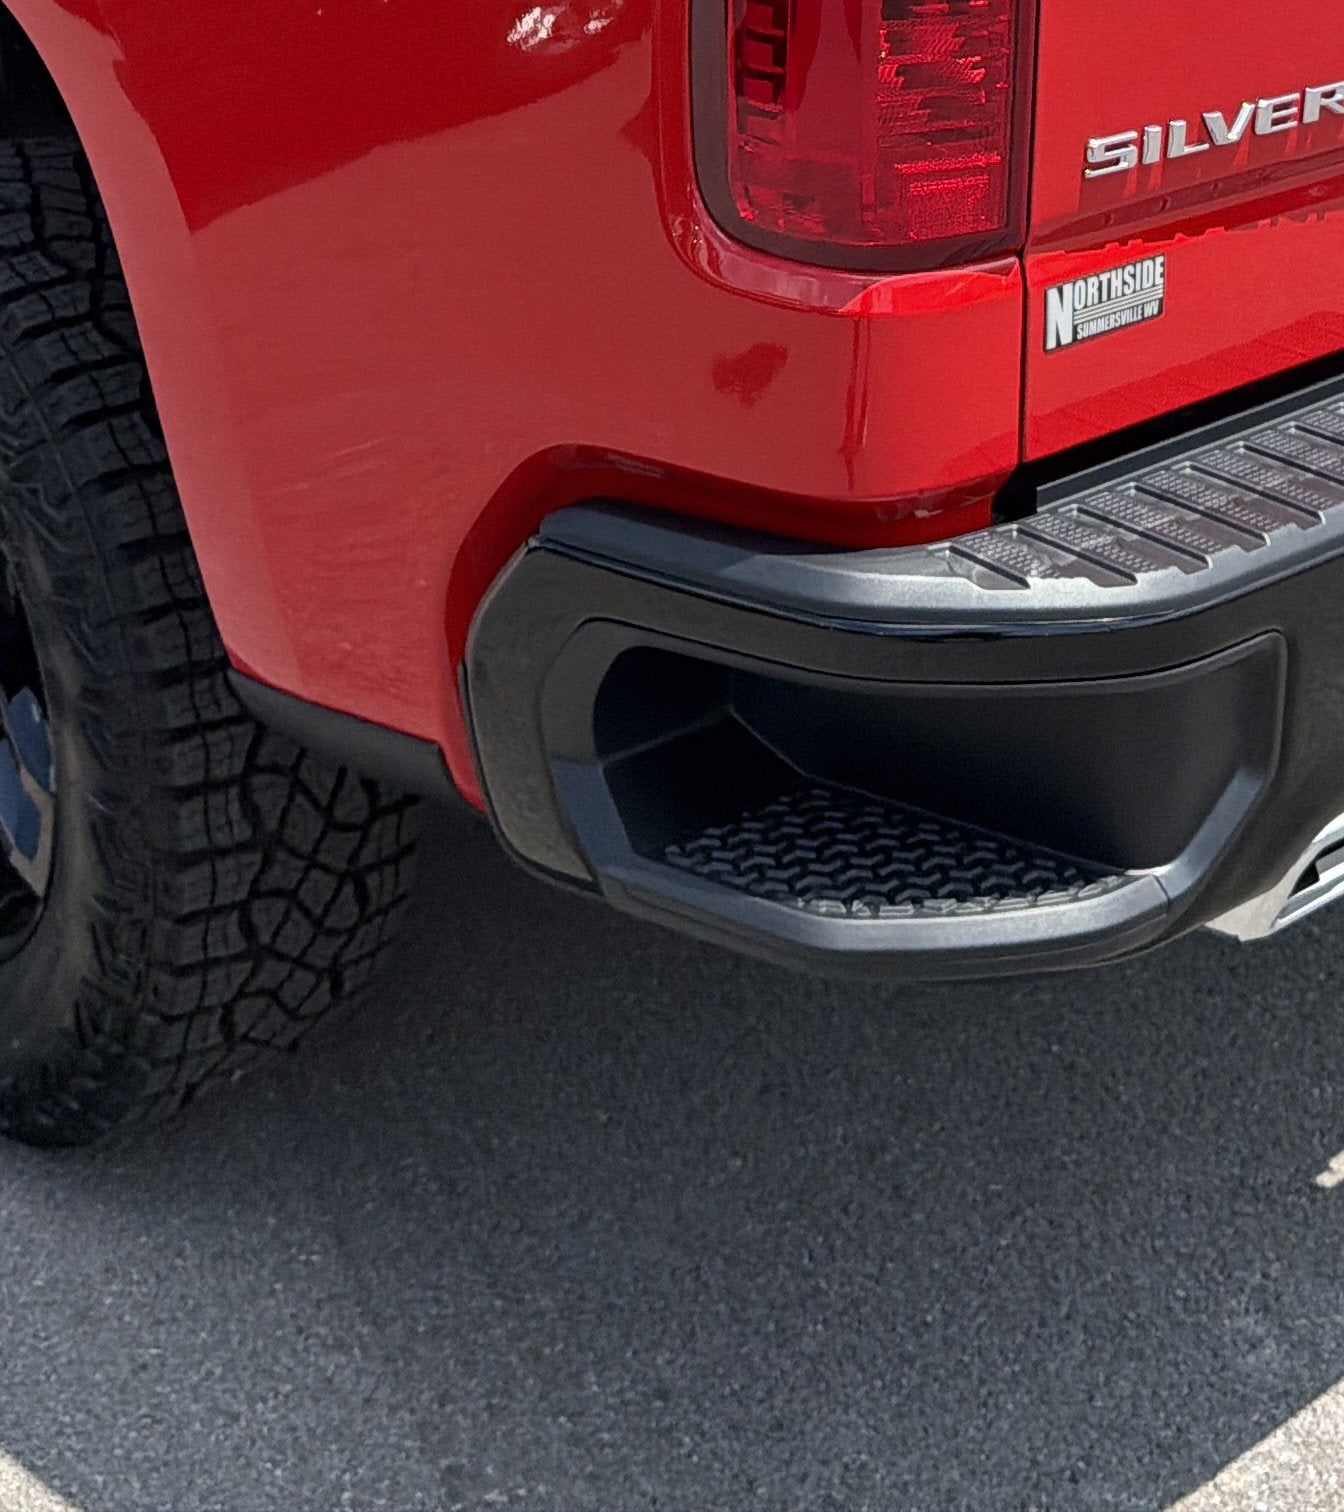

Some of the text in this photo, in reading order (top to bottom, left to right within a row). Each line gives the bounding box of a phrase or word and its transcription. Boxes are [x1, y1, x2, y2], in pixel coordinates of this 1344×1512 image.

[1045, 255, 1165, 351] NORTHSIDE
[1076, 299, 1160, 341] SUMMERSVILLE WV
